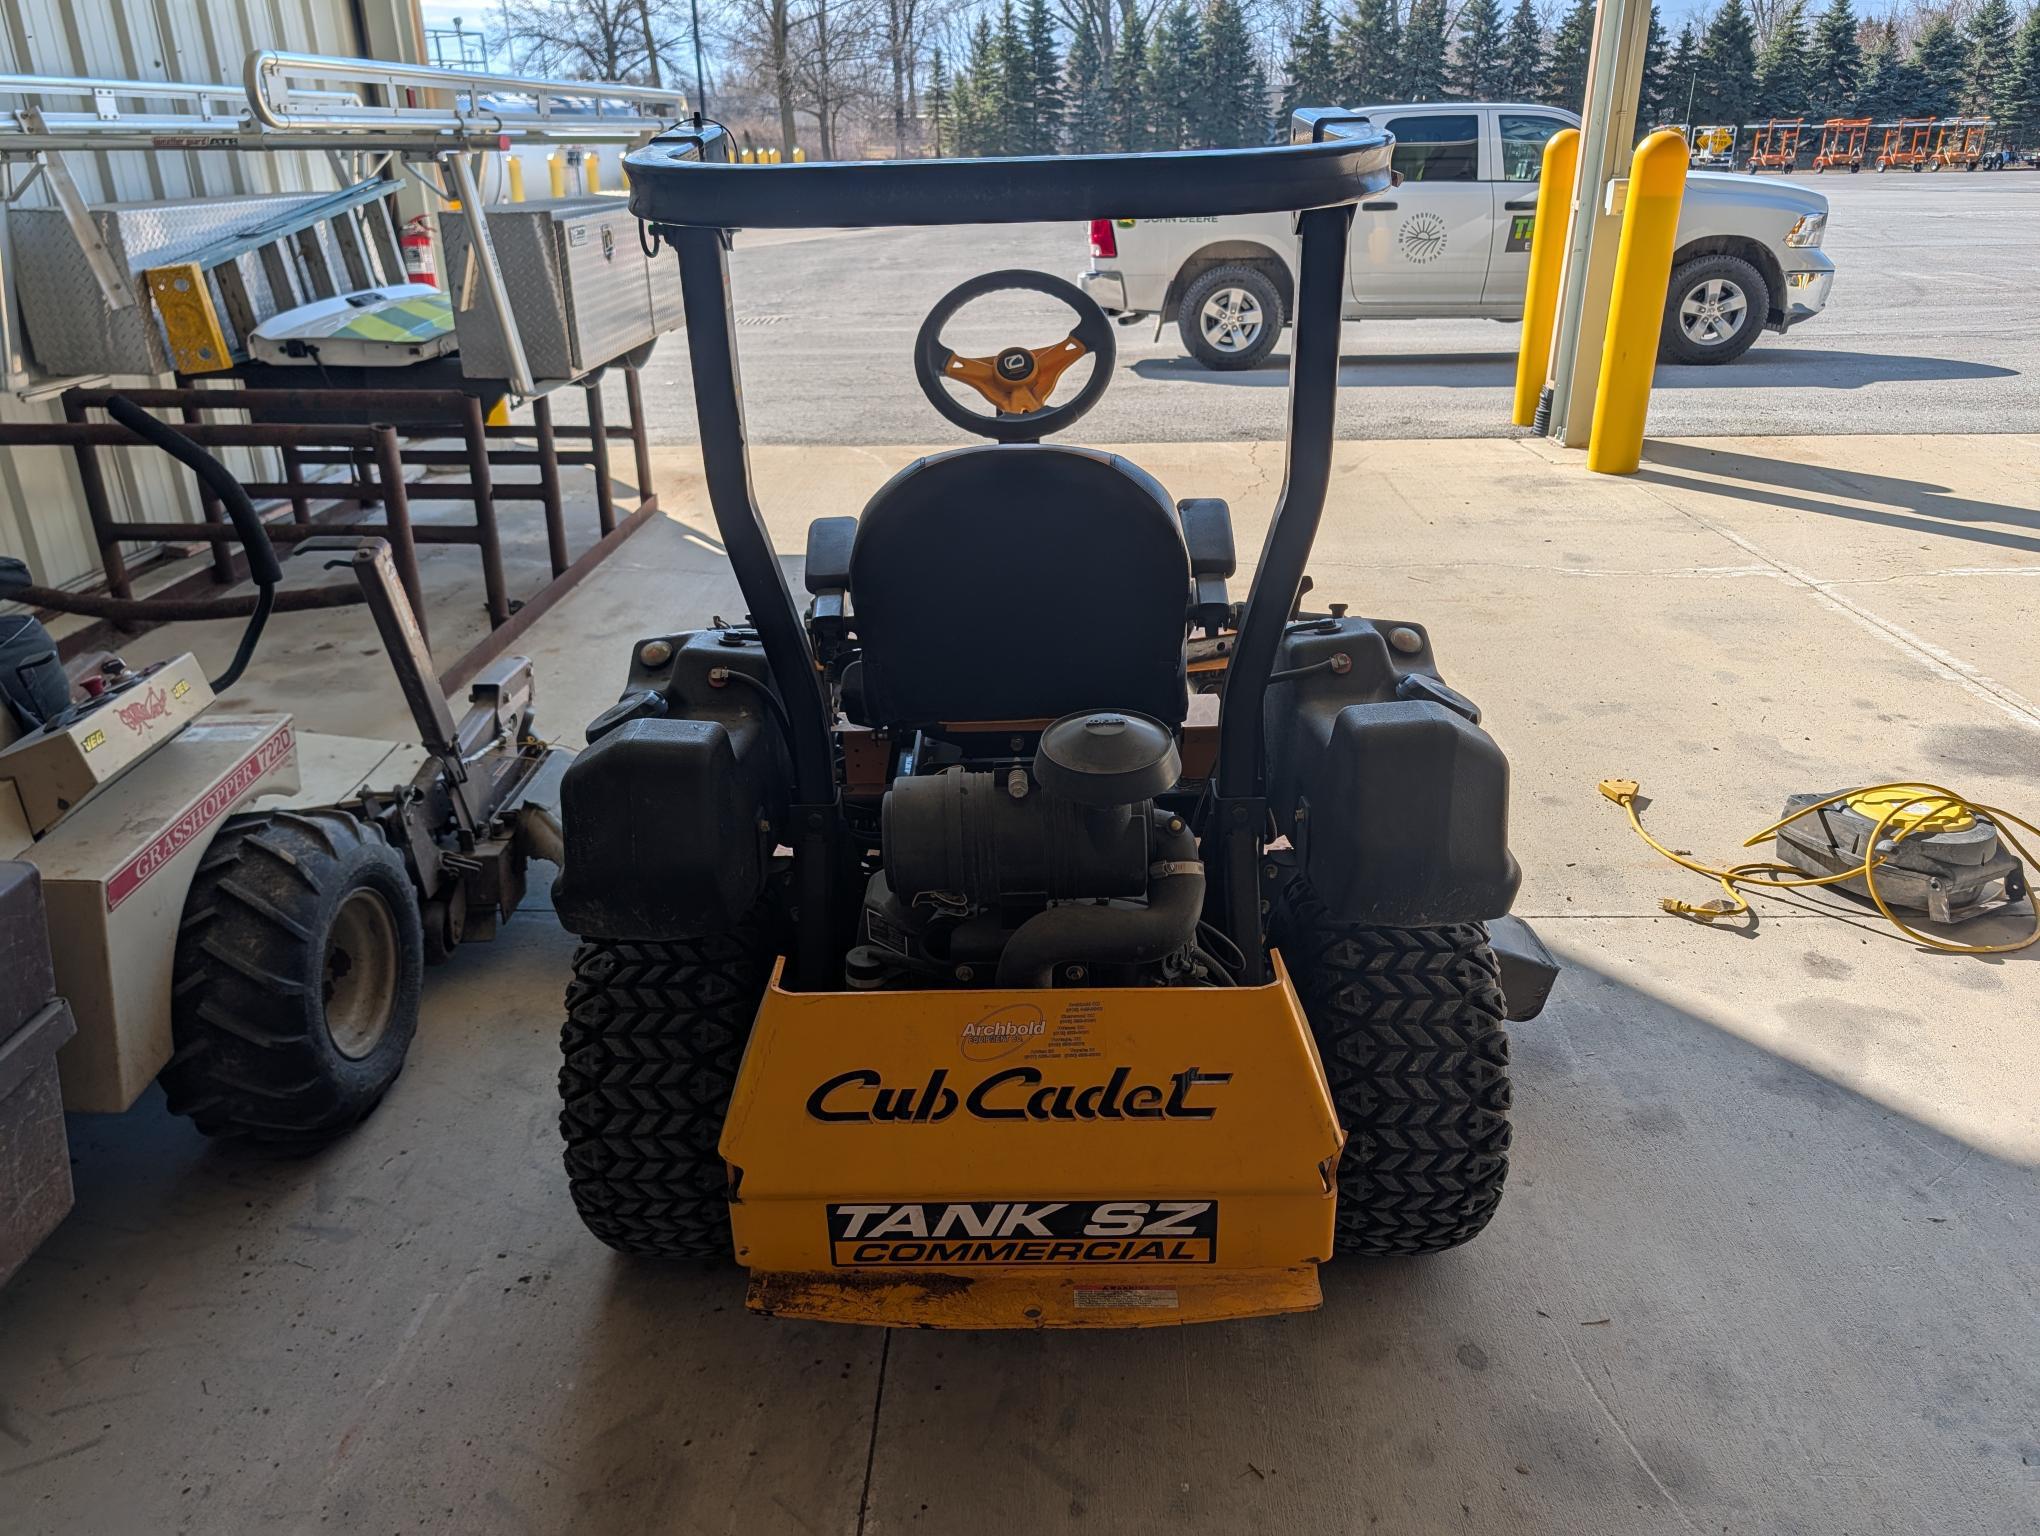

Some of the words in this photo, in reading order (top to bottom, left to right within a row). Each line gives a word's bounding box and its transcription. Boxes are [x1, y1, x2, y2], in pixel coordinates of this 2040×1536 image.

[135, 762, 254, 879] GRASSHOPPER
[963, 1021, 1046, 1036] Archbold
[806, 1068, 959, 1124] Cub
[966, 1067, 1233, 1124] Cadet
[836, 1203, 1071, 1238] TANK
[1084, 1202, 1212, 1237] SZ
[853, 1240, 1195, 1263] COMMERCIAL
